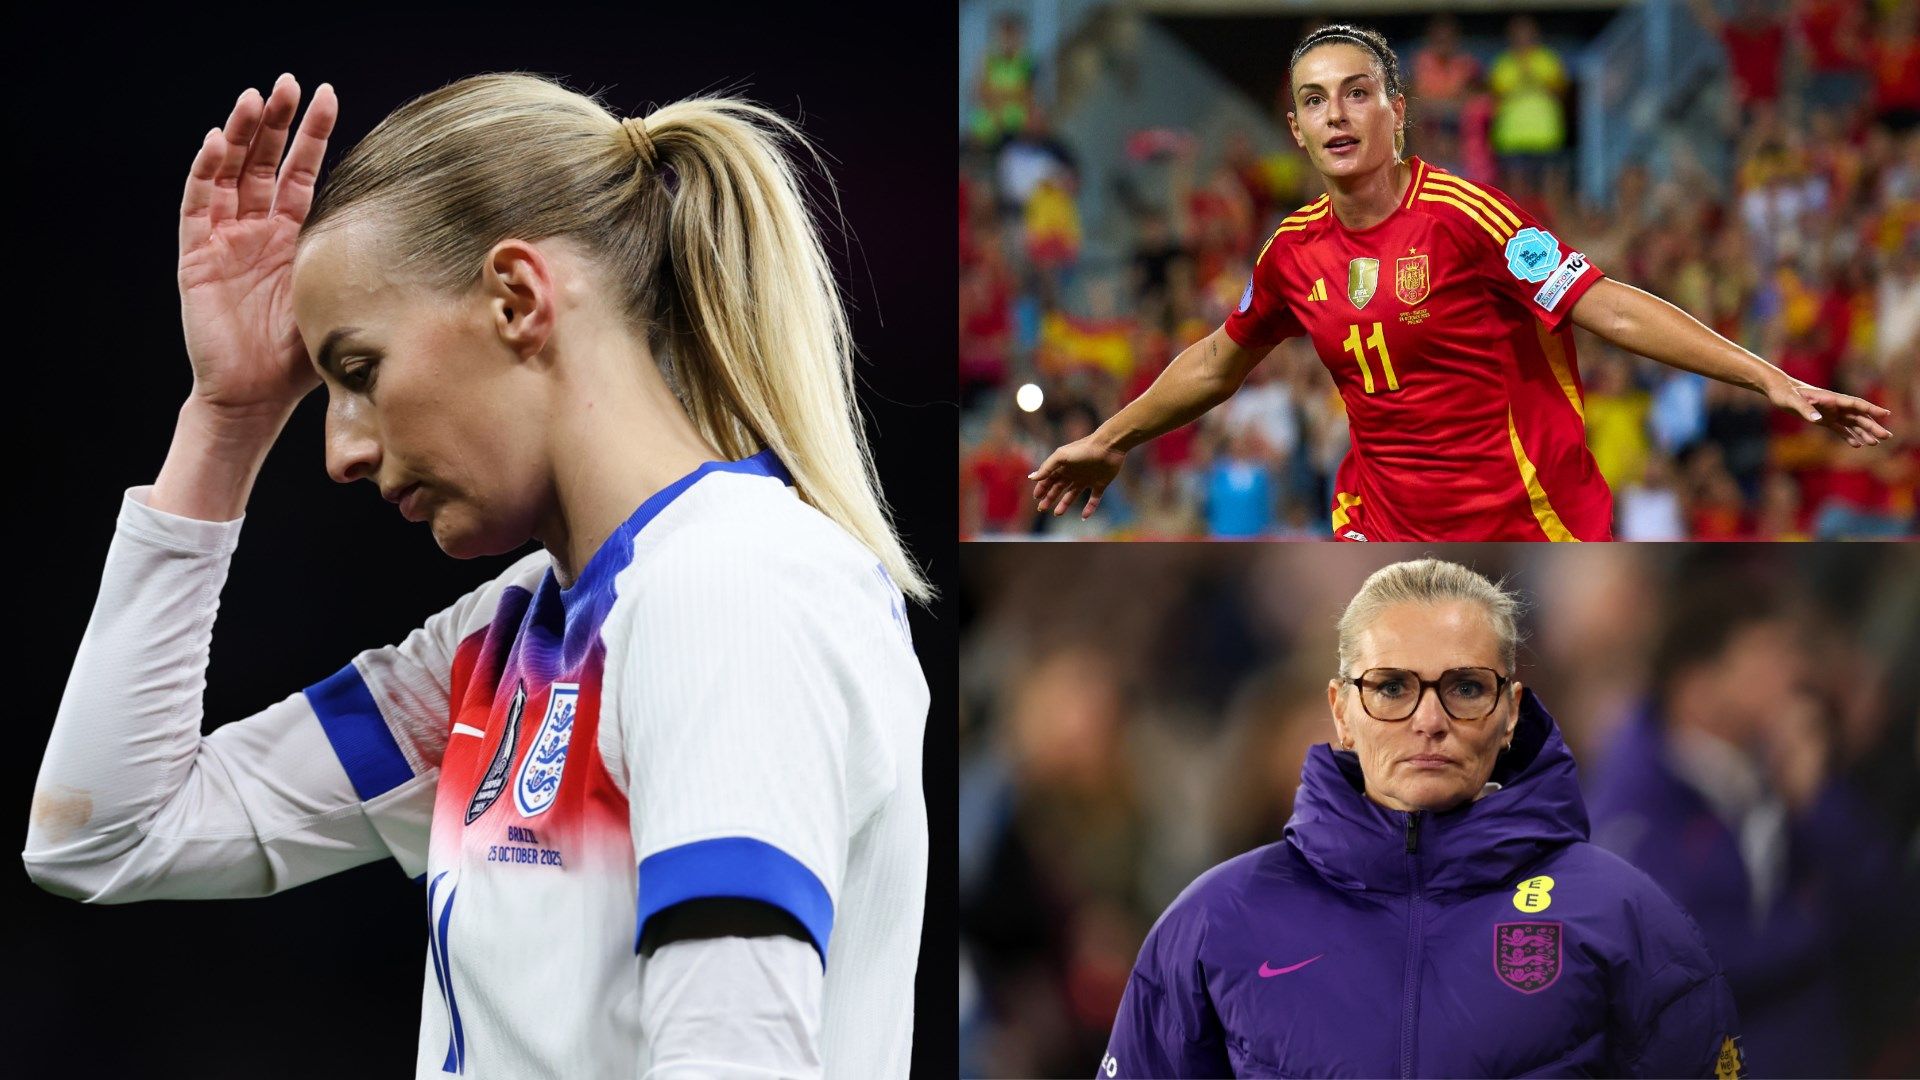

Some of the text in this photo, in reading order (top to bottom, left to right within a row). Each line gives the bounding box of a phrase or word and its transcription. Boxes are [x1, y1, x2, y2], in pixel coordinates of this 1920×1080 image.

[1343, 322, 1399, 393] 11
[508, 826, 538, 844] BRAZIL
[488, 846, 562, 865] 25 OCTOBER 2025
